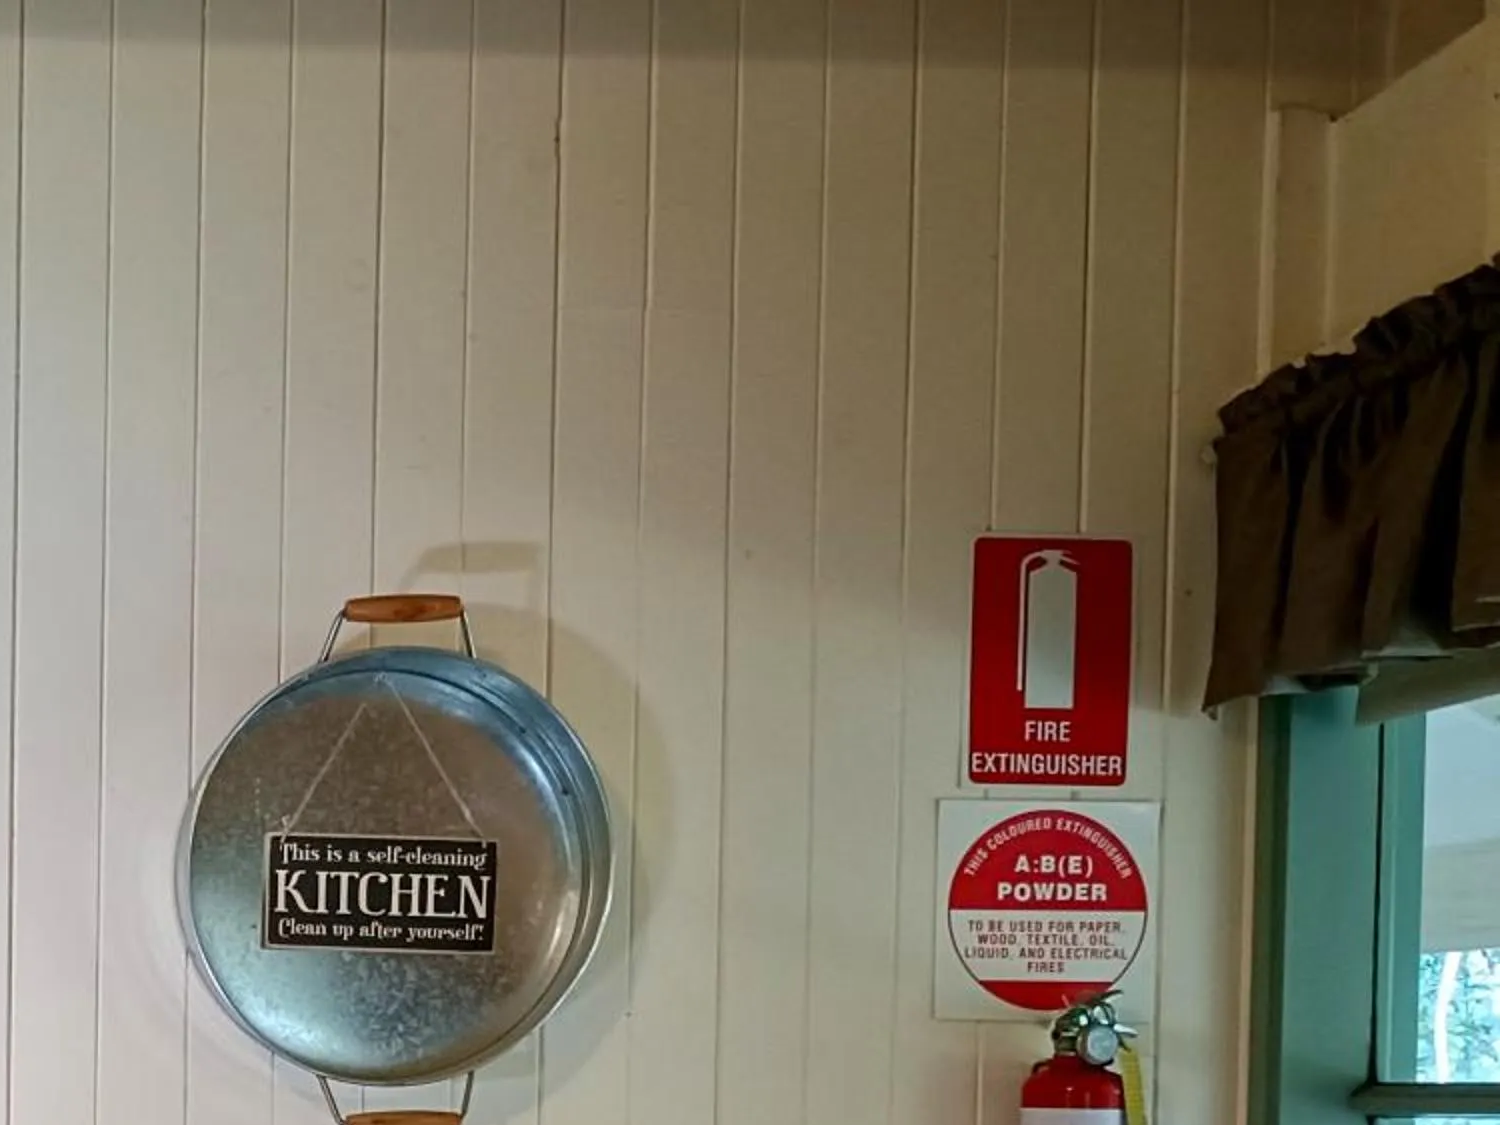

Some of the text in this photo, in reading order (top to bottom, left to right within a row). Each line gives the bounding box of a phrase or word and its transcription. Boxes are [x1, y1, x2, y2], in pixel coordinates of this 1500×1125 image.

[1024, 720, 1072, 743] FIRE
[971, 752, 1123, 777] EXTINGUISHER
[280, 842, 488, 871] This is a self-cleaning
[963, 817, 1133, 879] THIS COLOURED EXTINGUISHER
[1013, 853, 1094, 879] A:B(E)
[273, 868, 492, 920] KITCHEN
[996, 881, 1108, 902] POWDER
[277, 917, 327, 939] Clean
[332, 921, 354, 941] up
[358, 920, 402, 940] after
[967, 919, 984, 932] TO
[987, 920, 1004, 932] BE
[1009, 920, 1043, 933] USED
[1048, 921, 1075, 933] FOR
[1018, 948, 1046, 960] AND
[1050, 948, 1129, 961] ELECTRICAL
[1026, 961, 1066, 974] FIRES
